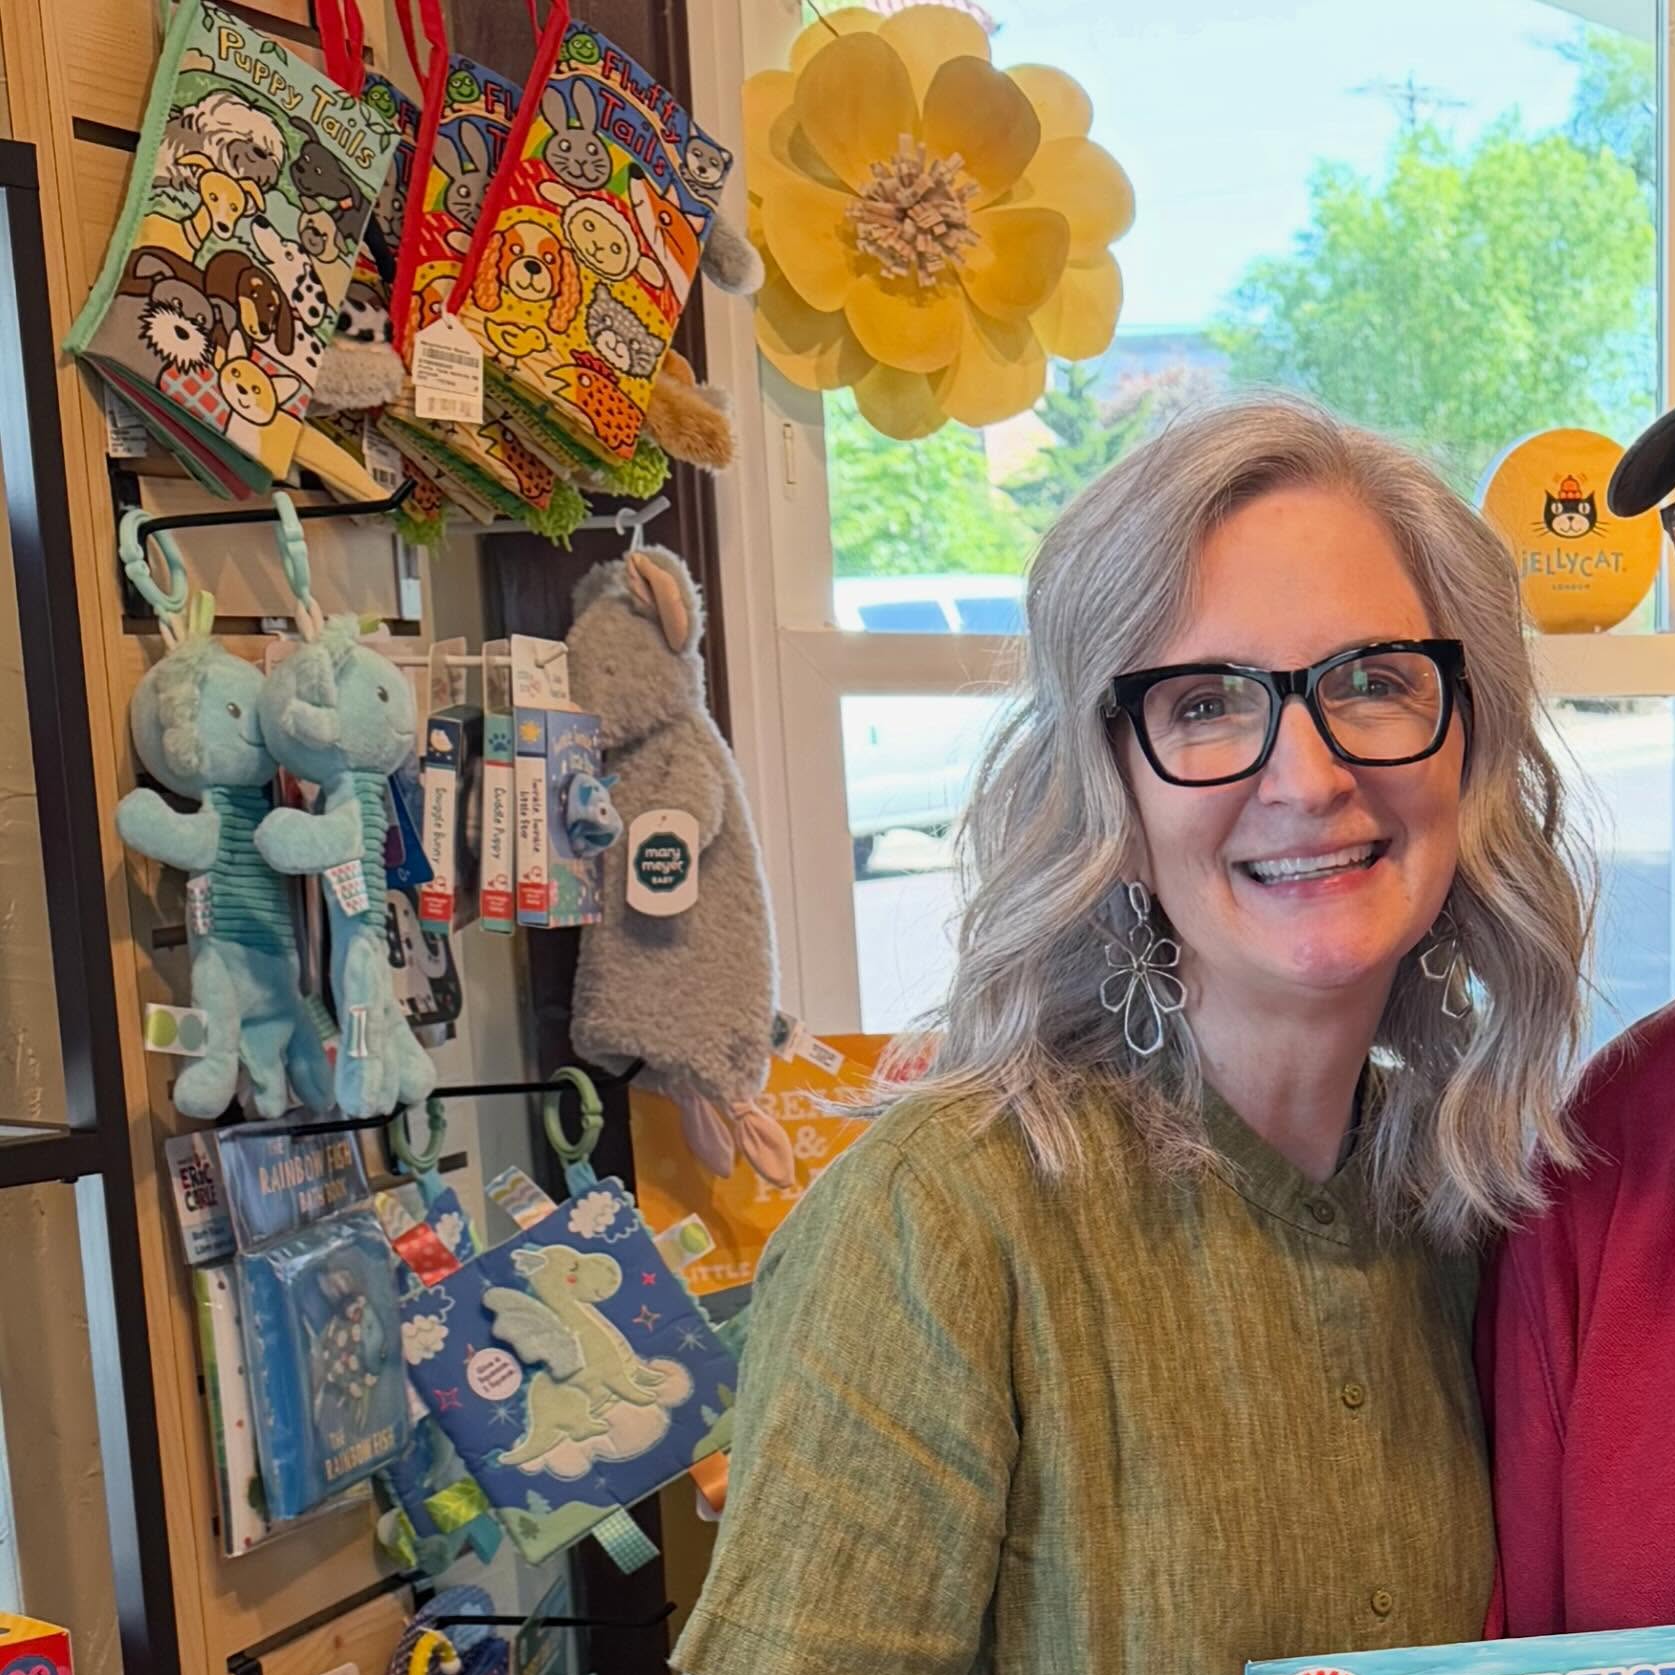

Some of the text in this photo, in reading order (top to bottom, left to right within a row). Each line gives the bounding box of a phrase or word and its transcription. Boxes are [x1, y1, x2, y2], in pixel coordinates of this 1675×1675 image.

[217, 26, 377, 169] Puppy Tails
[598, 88, 666, 177] Tails
[641, 861, 684, 874] meyer
[645, 848, 681, 861] mary
[180, 1164, 213, 1190] ERIC
